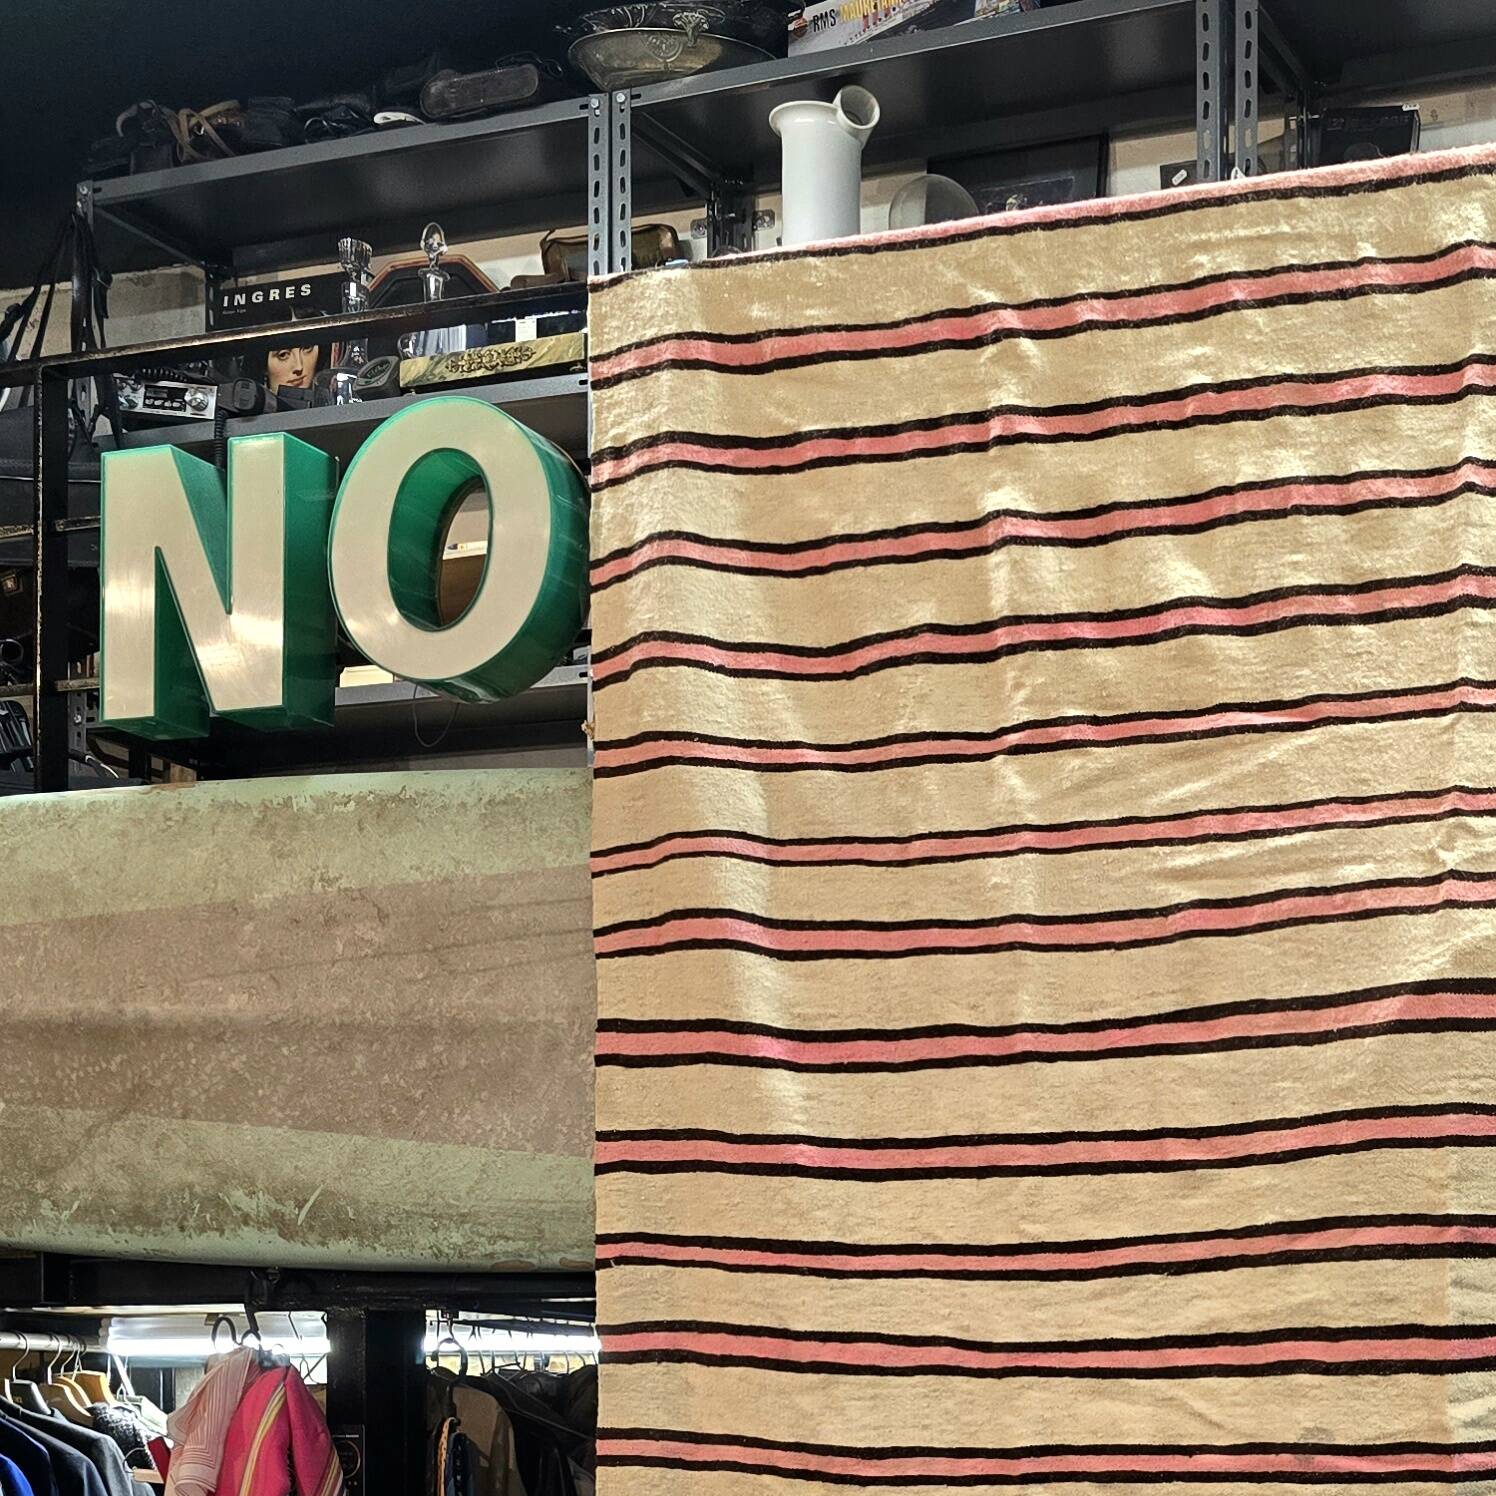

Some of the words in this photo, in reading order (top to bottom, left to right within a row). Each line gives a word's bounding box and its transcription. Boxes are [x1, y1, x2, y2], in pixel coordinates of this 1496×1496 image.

[812, 8, 837, 33] RMS
[222, 283, 312, 308] INGRES
[100, 395, 562, 726] NO
